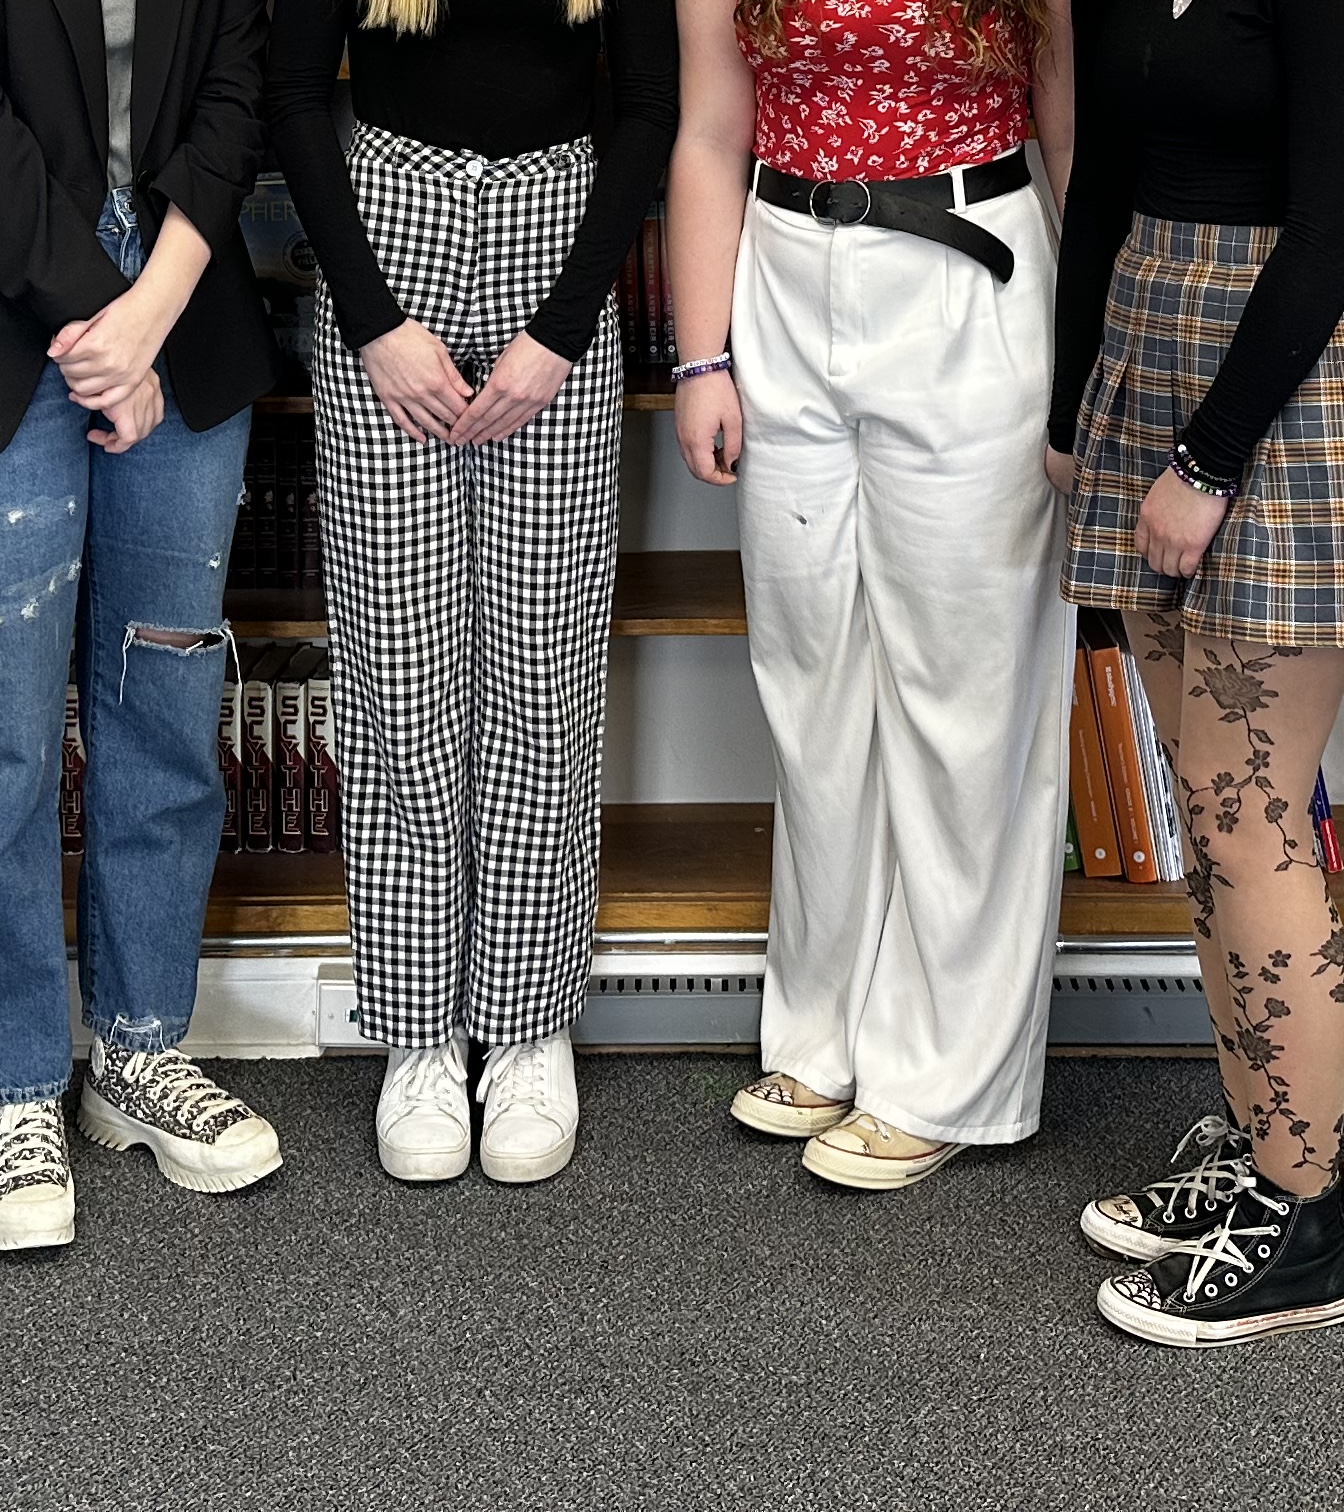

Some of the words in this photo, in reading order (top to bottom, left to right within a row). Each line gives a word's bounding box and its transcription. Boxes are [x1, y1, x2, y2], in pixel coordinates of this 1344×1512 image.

[246, 696, 267, 835] SCYTHE
[281, 695, 301, 835] SCYTHE
[309, 696, 329, 835] SCYTHE
